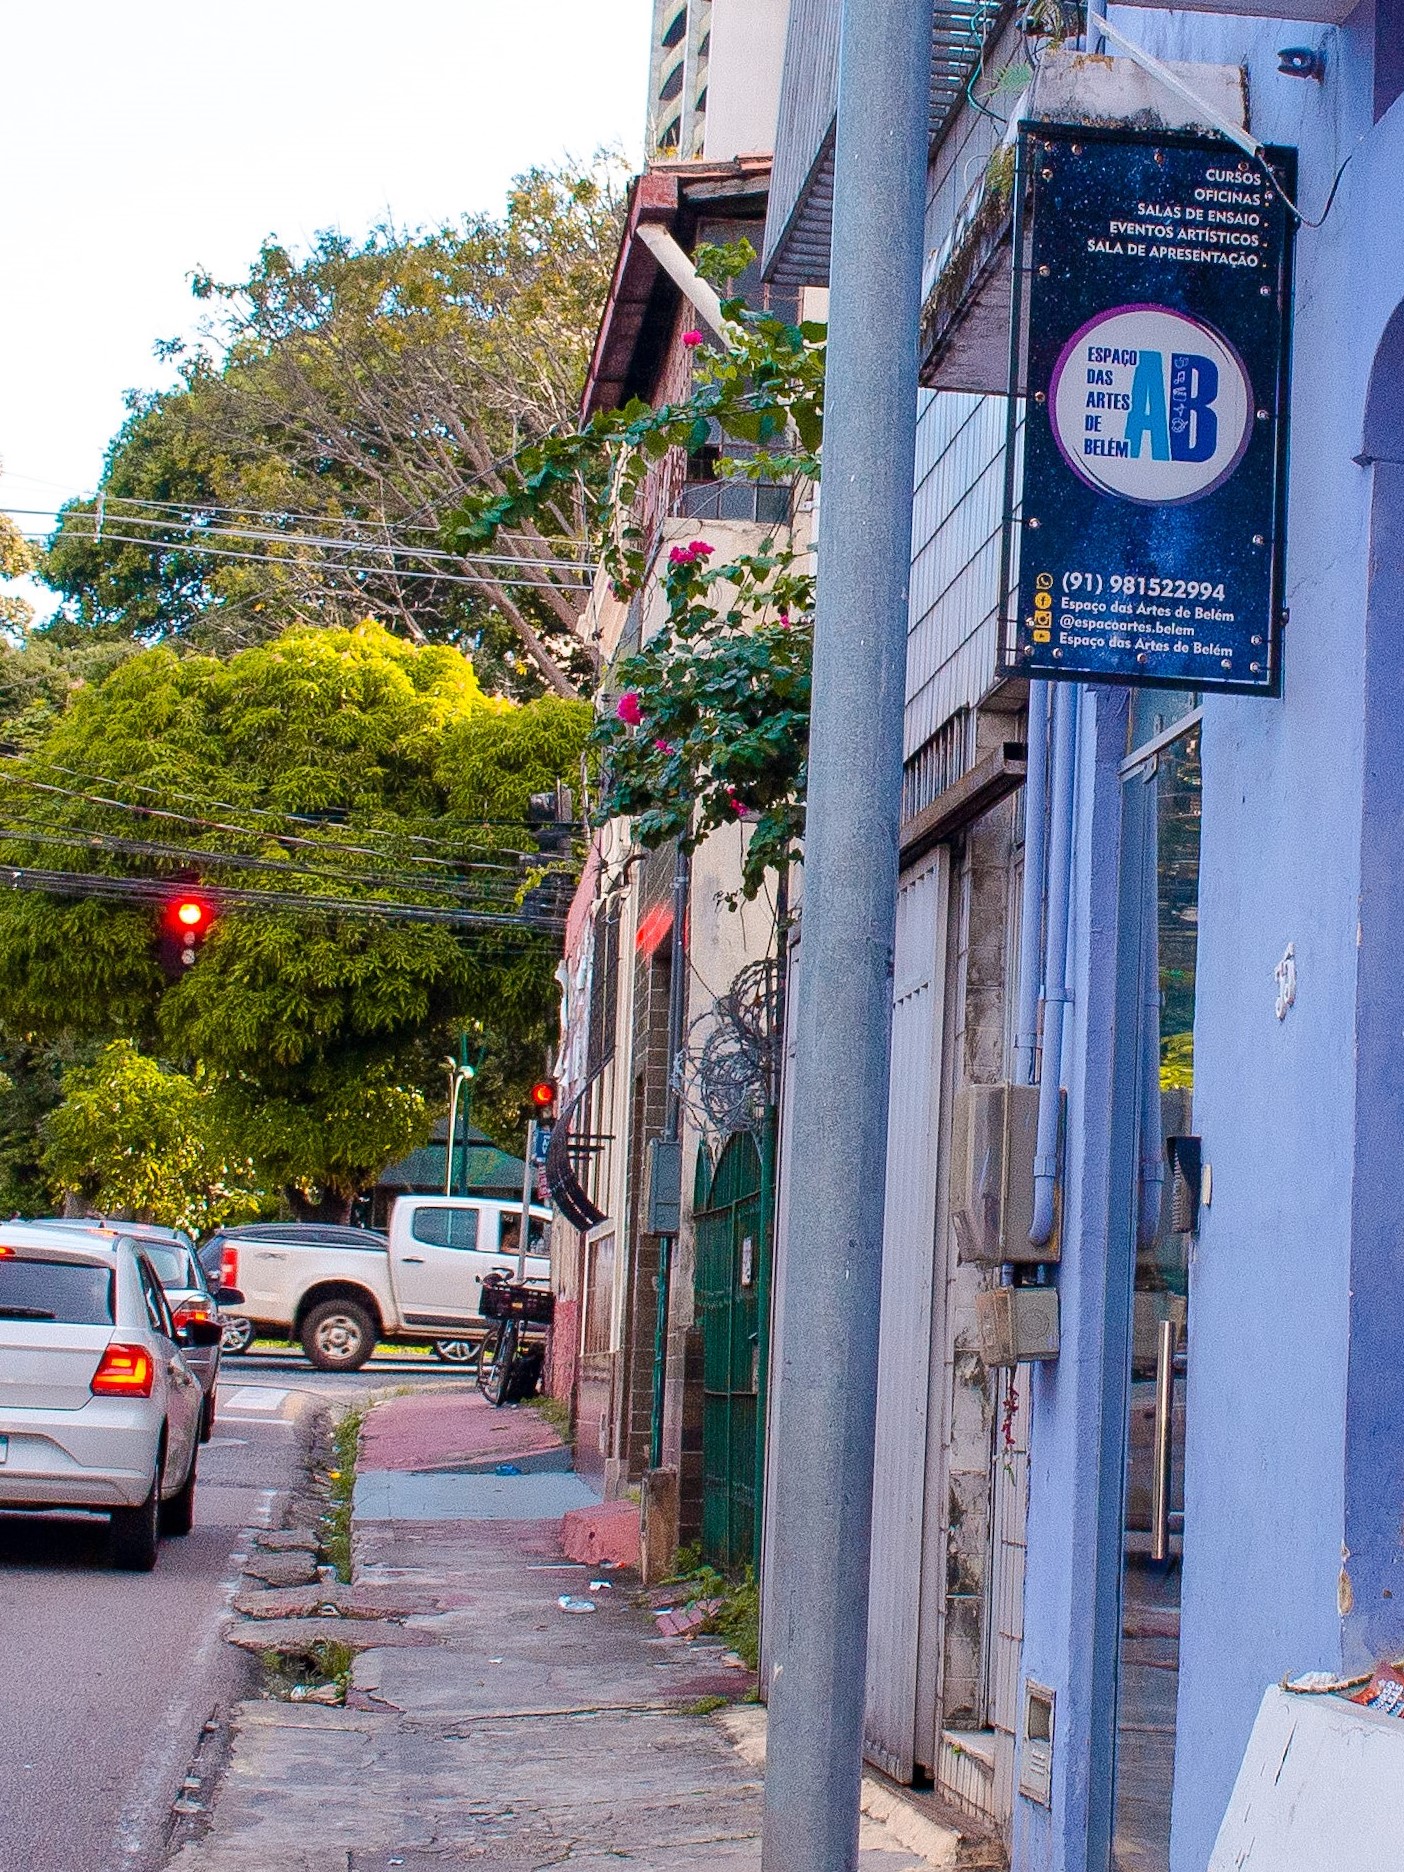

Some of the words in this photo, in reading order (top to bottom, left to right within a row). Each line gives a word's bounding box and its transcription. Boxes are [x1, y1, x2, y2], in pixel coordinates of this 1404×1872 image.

[1206, 169, 1261, 186] CURSOS
[1194, 188, 1260, 206] OFICINAS
[1138, 202, 1181, 219] SALAS
[1186, 208, 1204, 221] DE
[1208, 209, 1260, 226] ENSAIO
[1110, 221, 1174, 239] EVENTOS
[1178, 226, 1259, 247] ARTÍSTICOS
[1087, 239, 1123, 255] SALA
[1128, 244, 1146, 257] DE
[1149, 247, 1258, 268] APRESENTAÇÃO
[1088, 347, 1137, 367] ESPAÇO
[1087, 369, 1113, 385] DAS
[1086, 392, 1130, 410] ARTES
[1085, 415, 1101, 432] DE
[1084, 438, 1128, 458] BELÉM
[1062, 572, 1102, 594] (91)
[1110, 575, 1225, 601] 981522994
[1062, 597, 1106, 614] Espaço
[1111, 598, 1132, 613] das
[1136, 600, 1171, 617] Artes
[1175, 603, 1191, 618] de
[1195, 606, 1234, 621] Belém
[1060, 632, 1105, 649] Espaço
[1109, 634, 1131, 649] das
[1135, 637, 1169, 652] Artes
[1174, 640, 1189, 653] de
[1194, 641, 1233, 656] Belém
